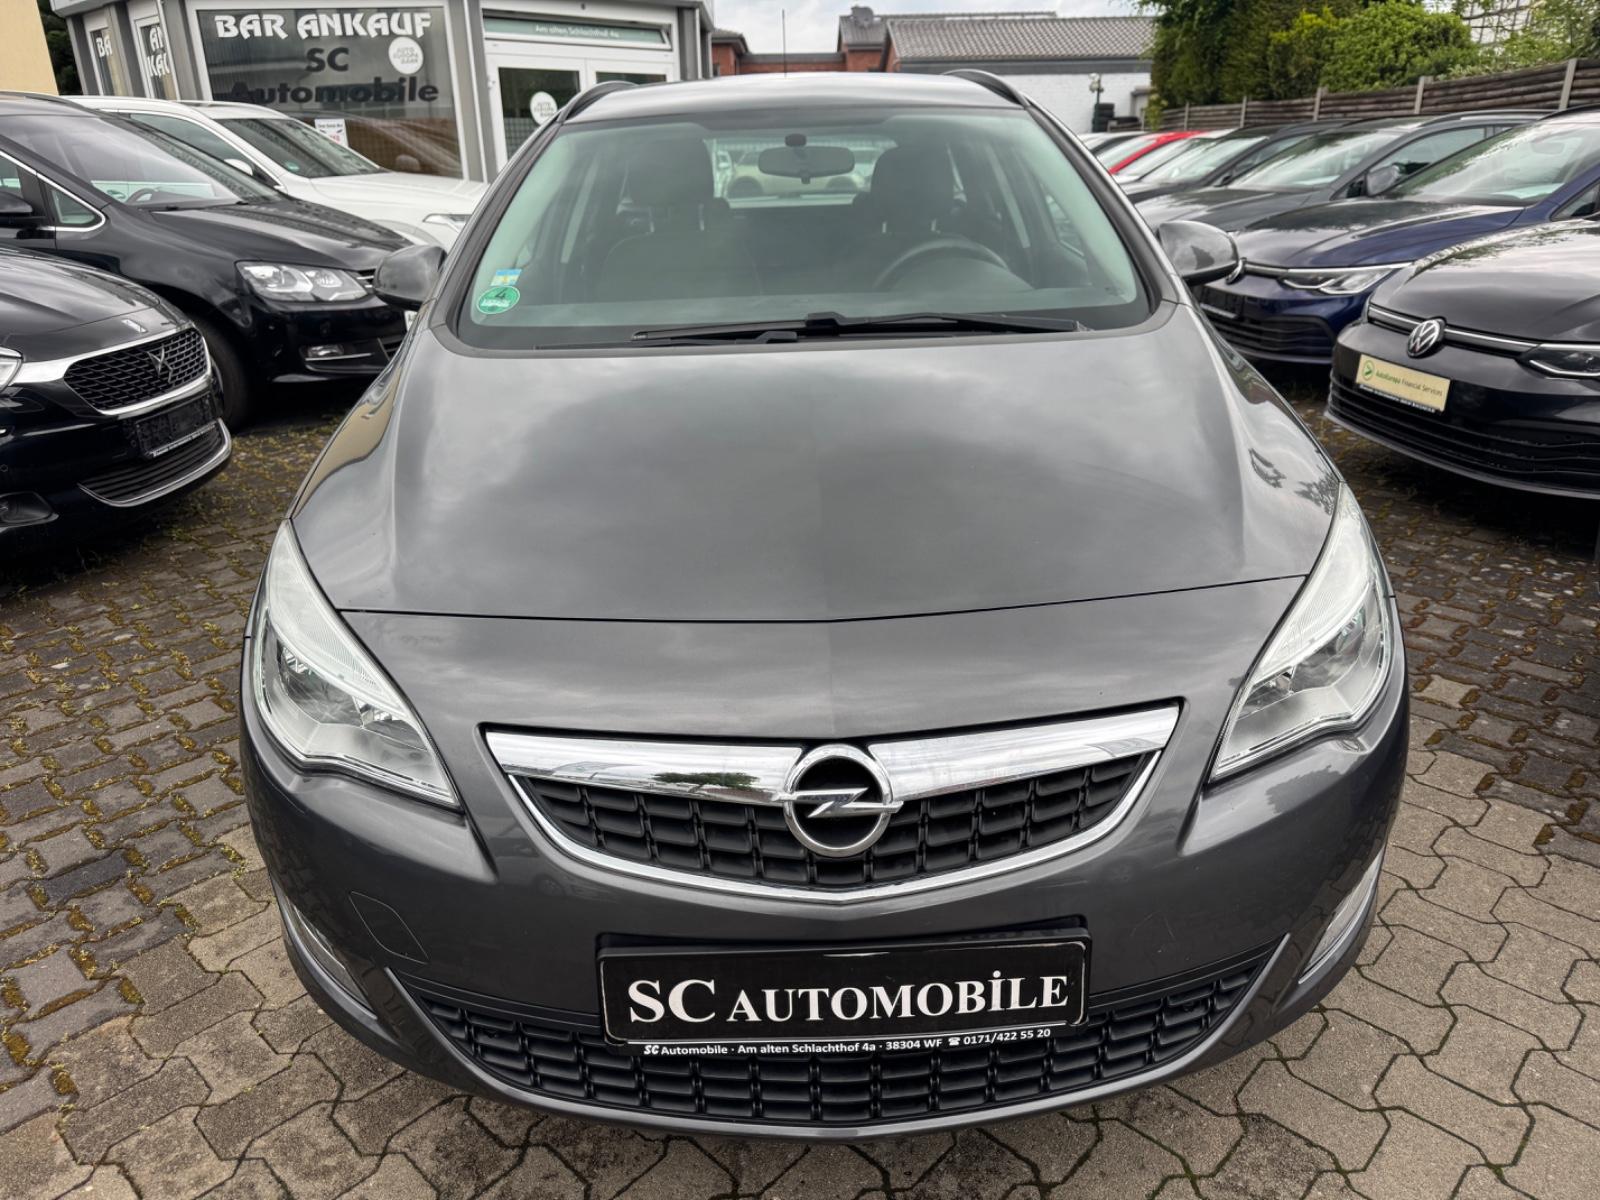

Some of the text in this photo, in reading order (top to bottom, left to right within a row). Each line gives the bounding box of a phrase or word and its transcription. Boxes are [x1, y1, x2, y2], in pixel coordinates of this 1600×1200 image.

[214, 12, 431, 39] BAR ANKAUF
[305, 46, 350, 73] SC
[231, 76, 438, 105] Automobile
[494, 286, 508, 299] 4
[627, 979, 716, 1023] SC
[644, 1028, 1051, 1055] SC Automobile Am alten Schlachthof 4a 38304 WF 0171/422 55 20
